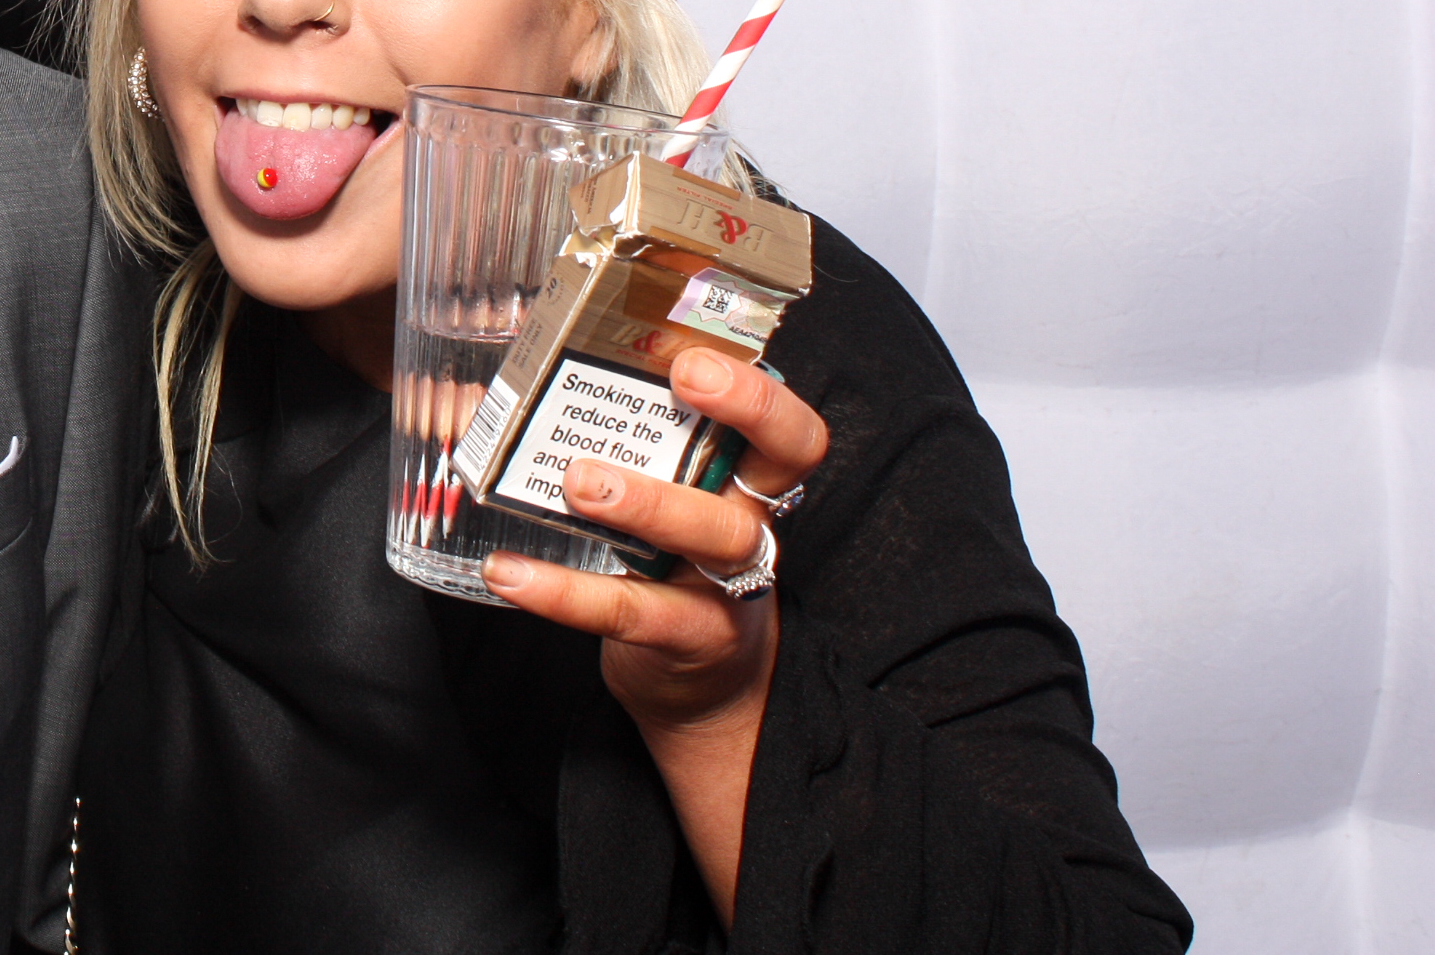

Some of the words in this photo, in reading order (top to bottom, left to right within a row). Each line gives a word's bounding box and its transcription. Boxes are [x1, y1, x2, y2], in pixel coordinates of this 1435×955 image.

[546, 277, 557, 300] 20
[562, 373, 645, 414] Smoking
[648, 401, 691, 428] may
[562, 404, 627, 433] reduce
[632, 421, 663, 444] the
[532, 451, 573, 472] and
[550, 424, 607, 454] blood
[608, 441, 652, 468] flow
[525, 472, 566, 501] imp
